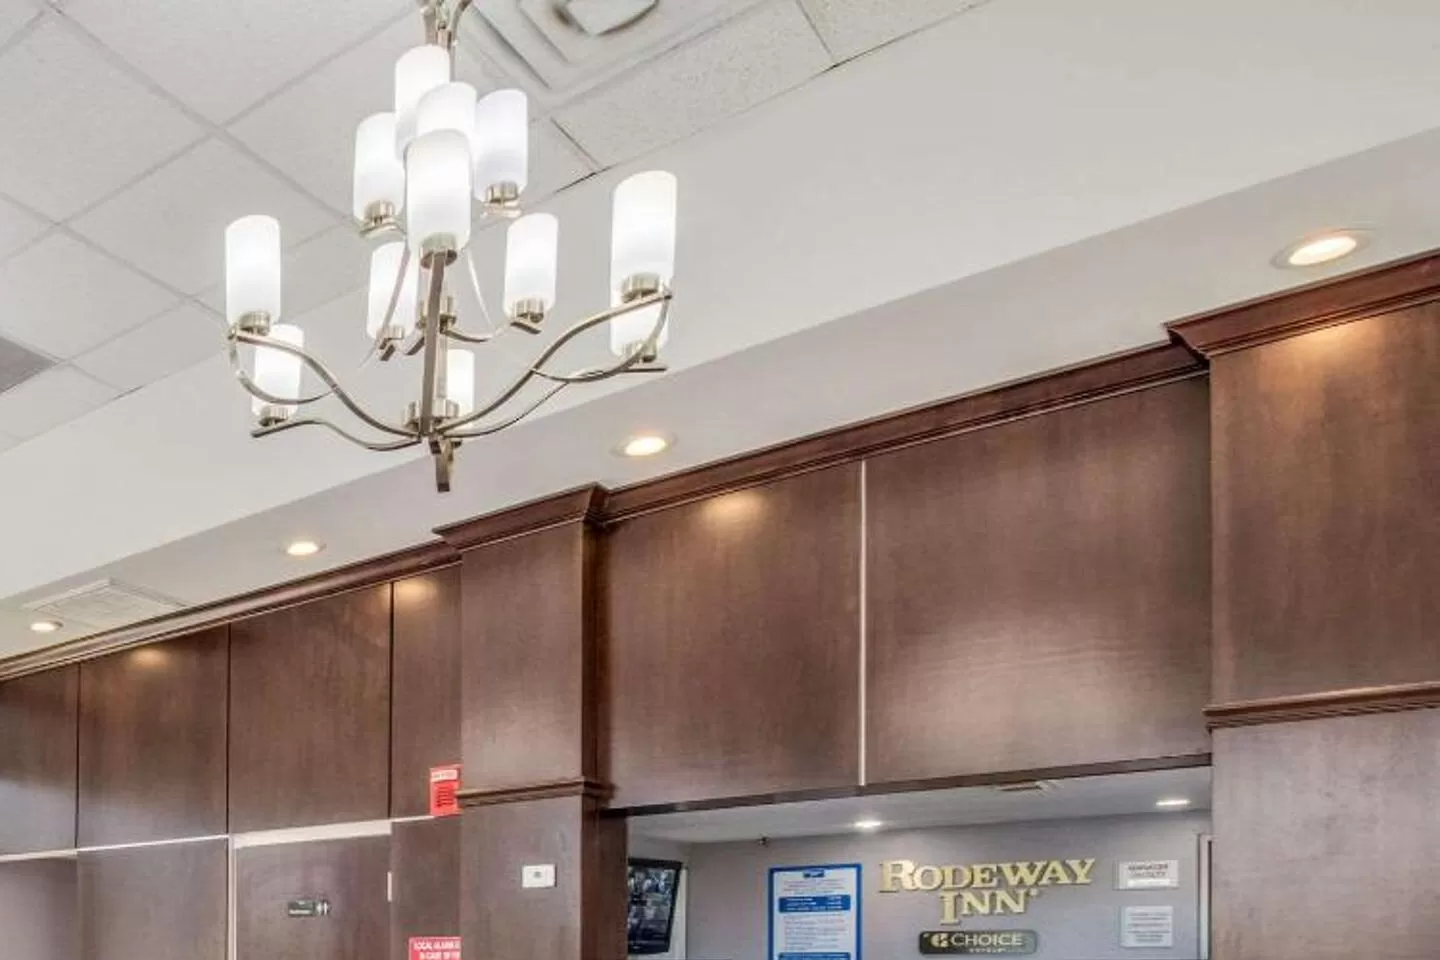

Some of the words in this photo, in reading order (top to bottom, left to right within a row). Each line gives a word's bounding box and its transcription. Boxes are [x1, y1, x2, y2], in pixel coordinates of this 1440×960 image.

[879, 858, 1095, 893] RODEWAY
[940, 889, 1028, 925] INN
[951, 932, 1024, 947] CHOICE
